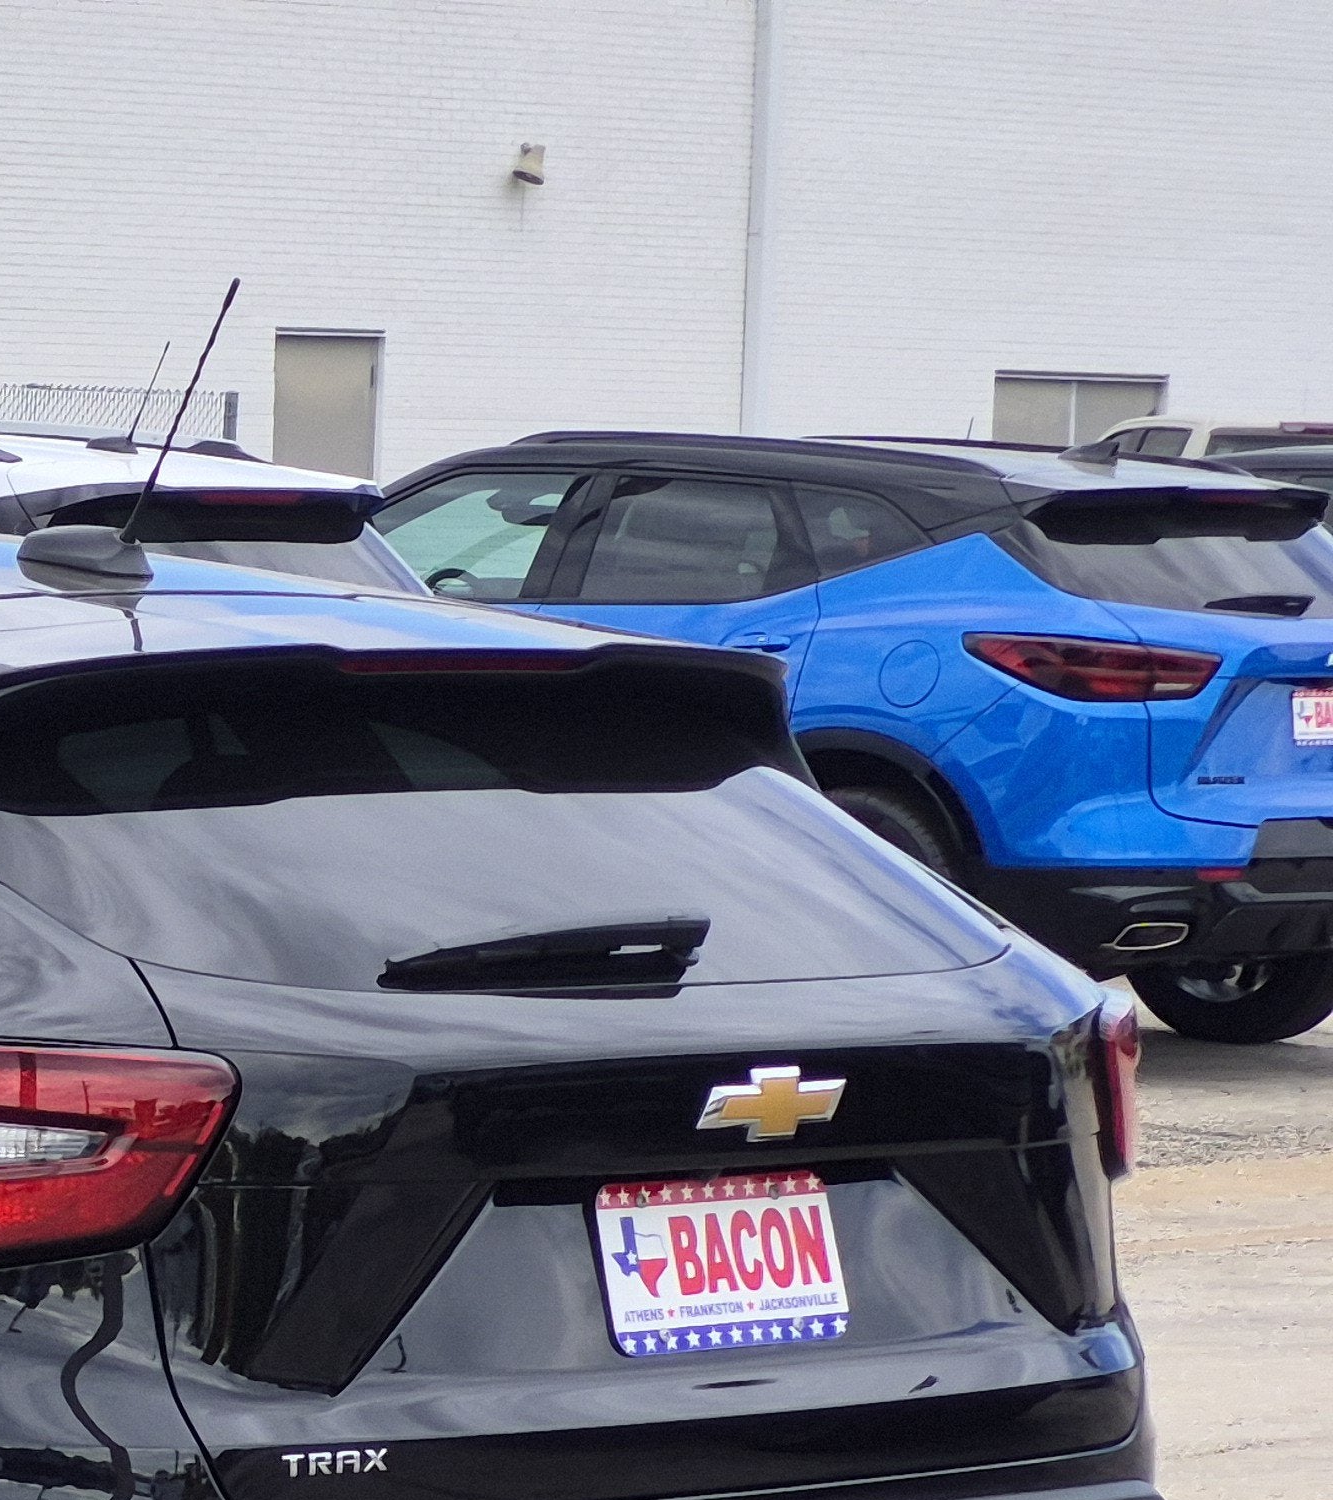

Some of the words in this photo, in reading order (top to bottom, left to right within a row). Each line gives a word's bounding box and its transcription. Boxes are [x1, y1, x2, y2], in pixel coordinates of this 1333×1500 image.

[668, 1205, 832, 1295] BACON
[624, 1308, 664, 1323] ATHENS
[679, 1301, 744, 1318] FRANKSTON
[759, 1293, 838, 1312] JACKSONVILLE
[281, 1447, 388, 1478] TRAX
